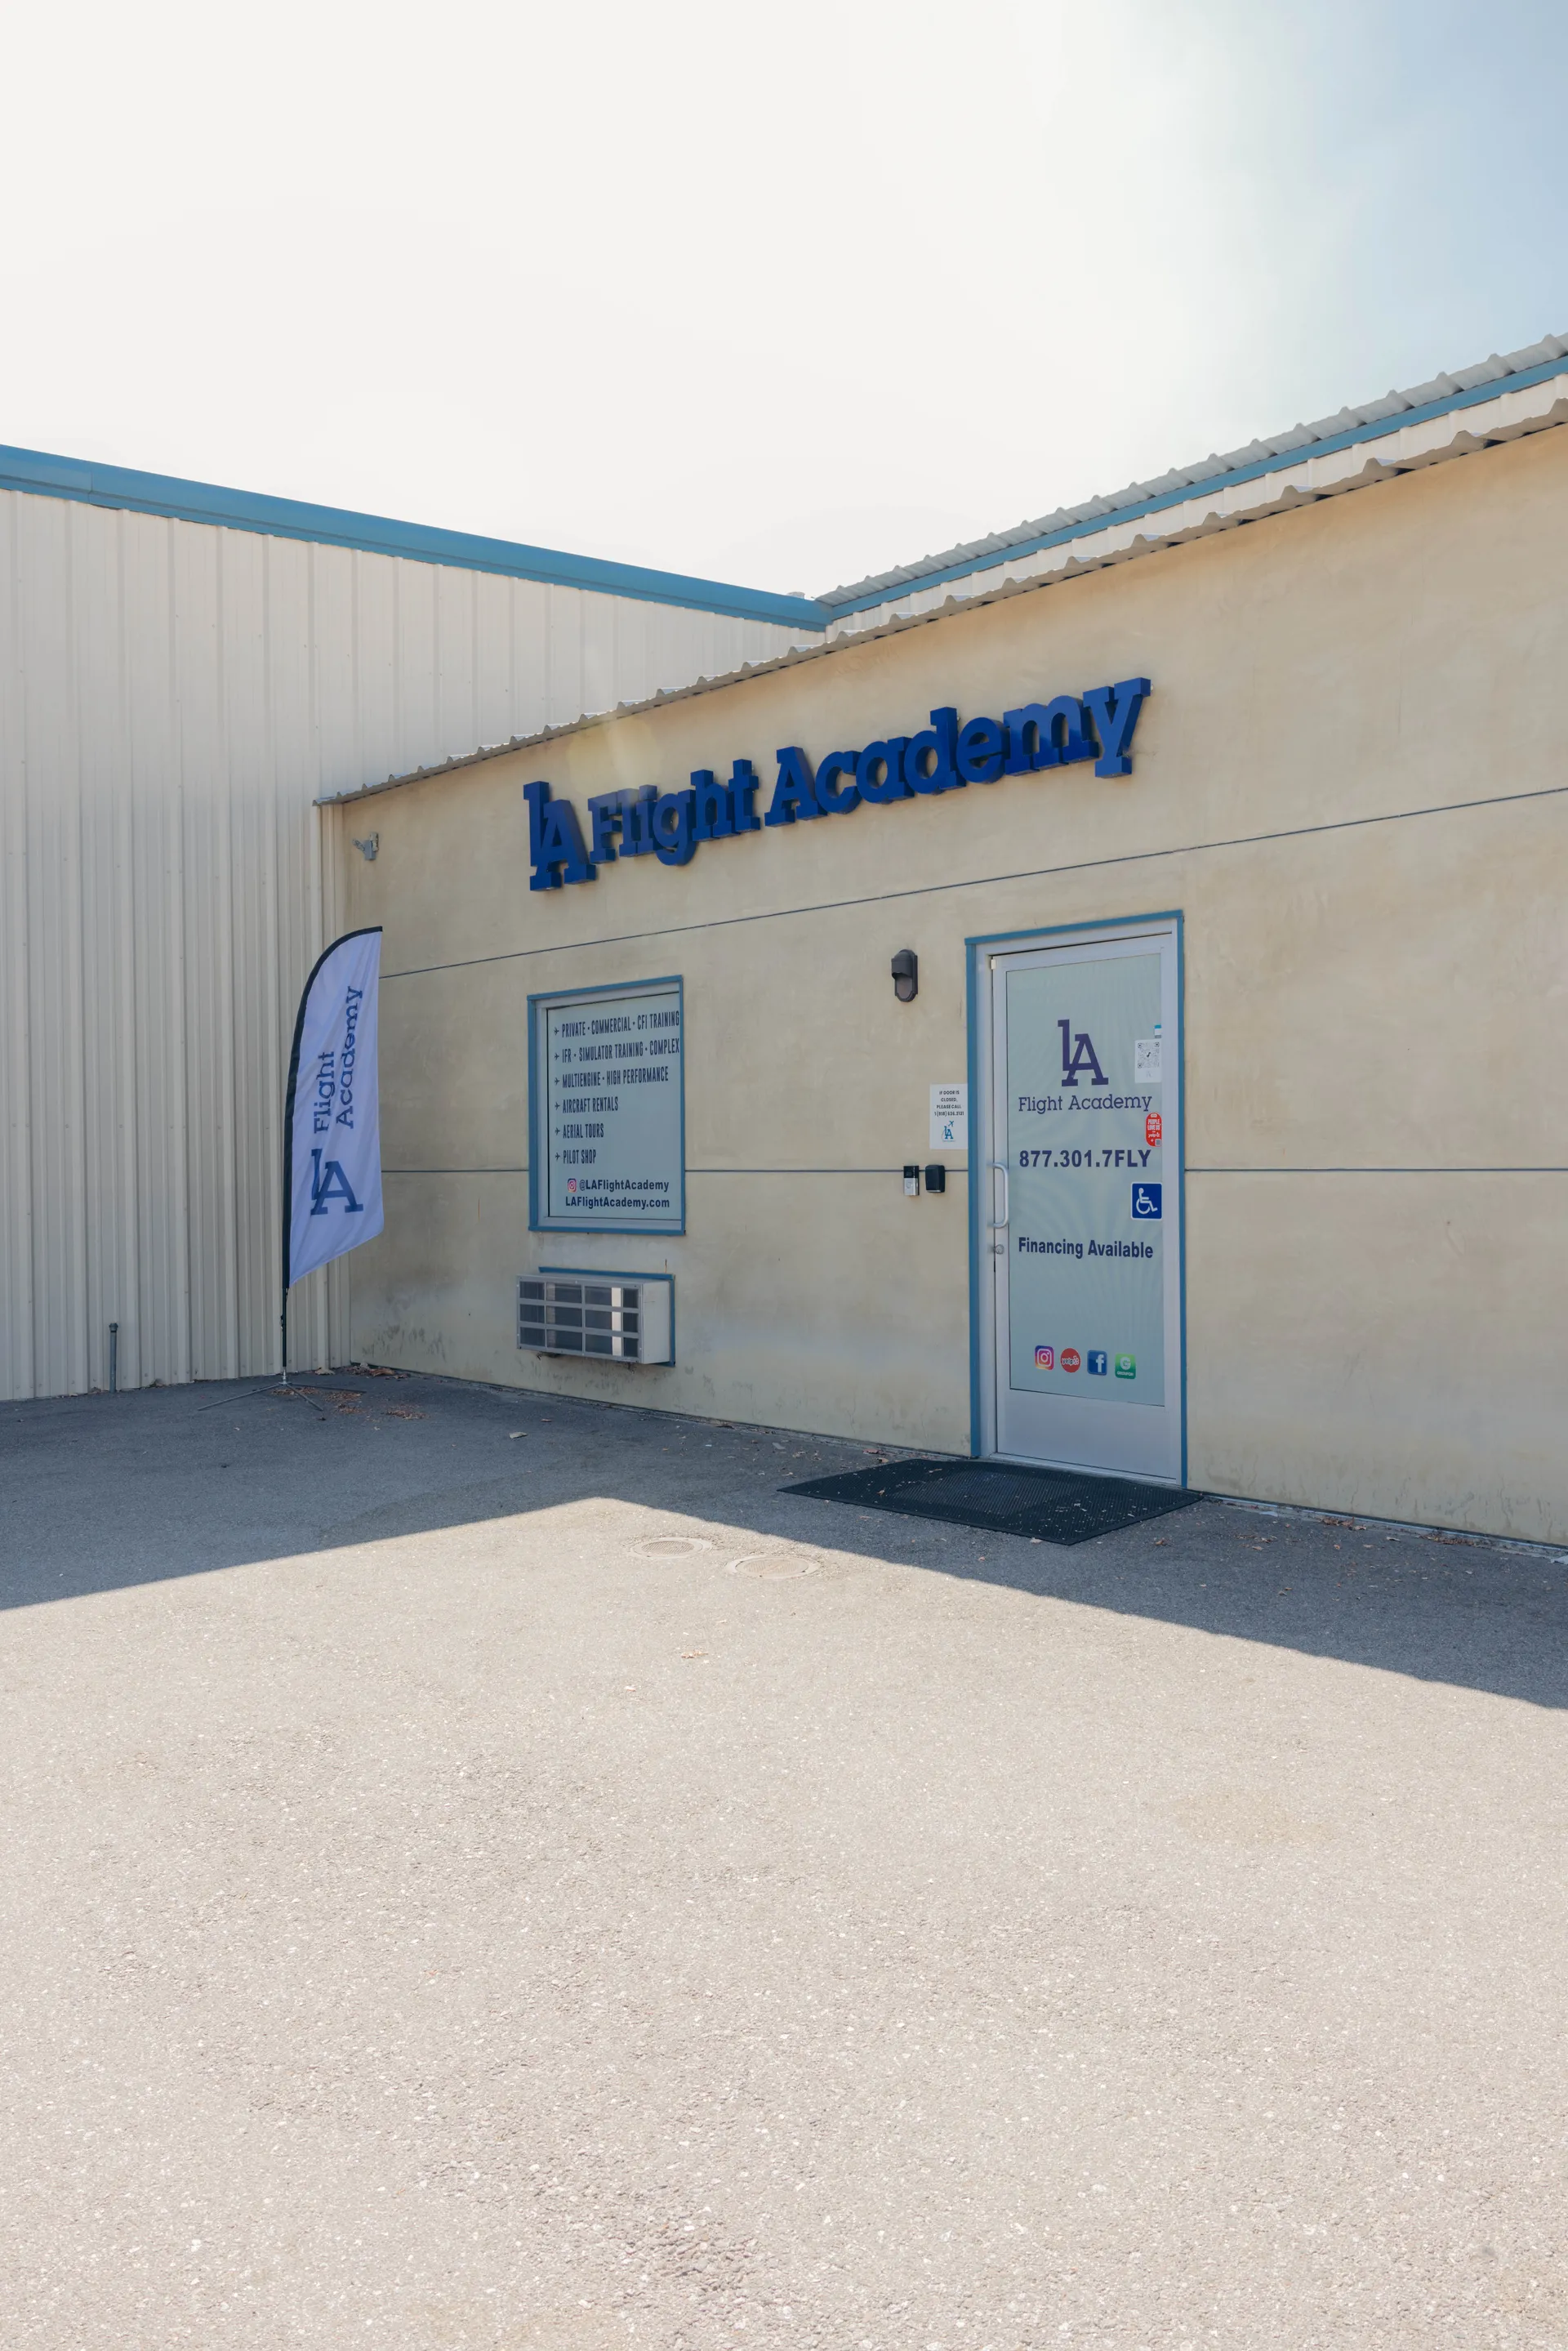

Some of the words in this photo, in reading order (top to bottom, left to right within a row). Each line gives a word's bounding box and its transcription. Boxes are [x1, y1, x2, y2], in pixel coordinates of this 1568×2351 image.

[523, 781, 596, 891] LA
[588, 759, 761, 866] Flight
[765, 677, 1152, 828] Academy
[562, 1021, 586, 1037] PRIVATE
[591, 1016, 631, 1035] COMMERCIAL
[638, 1015, 648, 1030] CFI
[650, 1010, 679, 1028] TRAINING
[336, 985, 363, 1130] Academy
[562, 1048, 572, 1063] IFR
[579, 1044, 612, 1061] SIMULATOR
[615, 1041, 644, 1059] TRAINING
[649, 1037, 679, 1055] COMPLEX
[1058, 1019, 1109, 1086] LA
[562, 1071, 601, 1088] MULTIENGINE
[607, 1069, 621, 1086] HIGH
[623, 1065, 669, 1084] PERFORMANCE
[314, 1051, 335, 1134] Flight
[563, 1097, 590, 1113] AIRCRAFT
[592, 1095, 619, 1112] RENTALS
[1018, 1095, 1063, 1114] Flight
[1067, 1093, 1152, 1112] Academy
[563, 1124, 583, 1139] AERIAL
[585, 1122, 604, 1138] TOURS
[563, 1149, 579, 1164] PILOT
[581, 1149, 597, 1164] SHOP
[1019, 1149, 1152, 1167] 877.301.7FLY
[310, 1148, 364, 1216] LA
[579, 1179, 670, 1193] @LAFlightAcademy
[565, 1196, 670, 1210] LAFlightAcademy.com
[1018, 1237, 1084, 1260] Financing
[1088, 1239, 1154, 1259] Available
